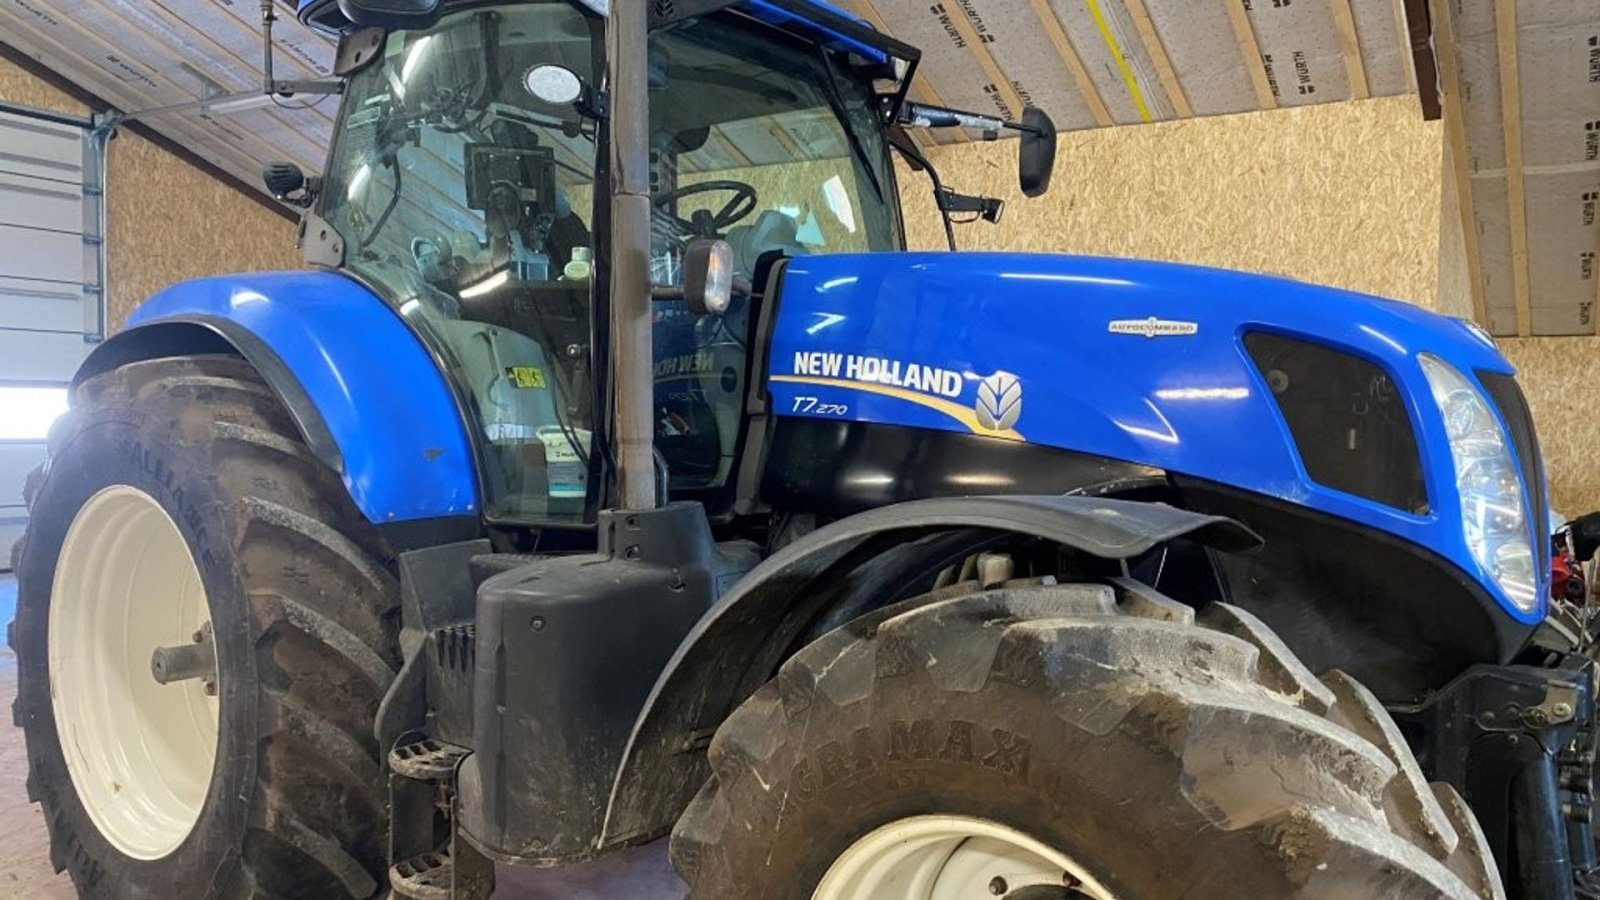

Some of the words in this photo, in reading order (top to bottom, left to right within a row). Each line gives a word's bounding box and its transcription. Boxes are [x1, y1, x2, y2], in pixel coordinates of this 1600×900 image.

[1111, 322, 1194, 332] AUTOCOMMAND
[794, 351, 843, 377] NEW
[846, 354, 963, 398] HOLLAND
